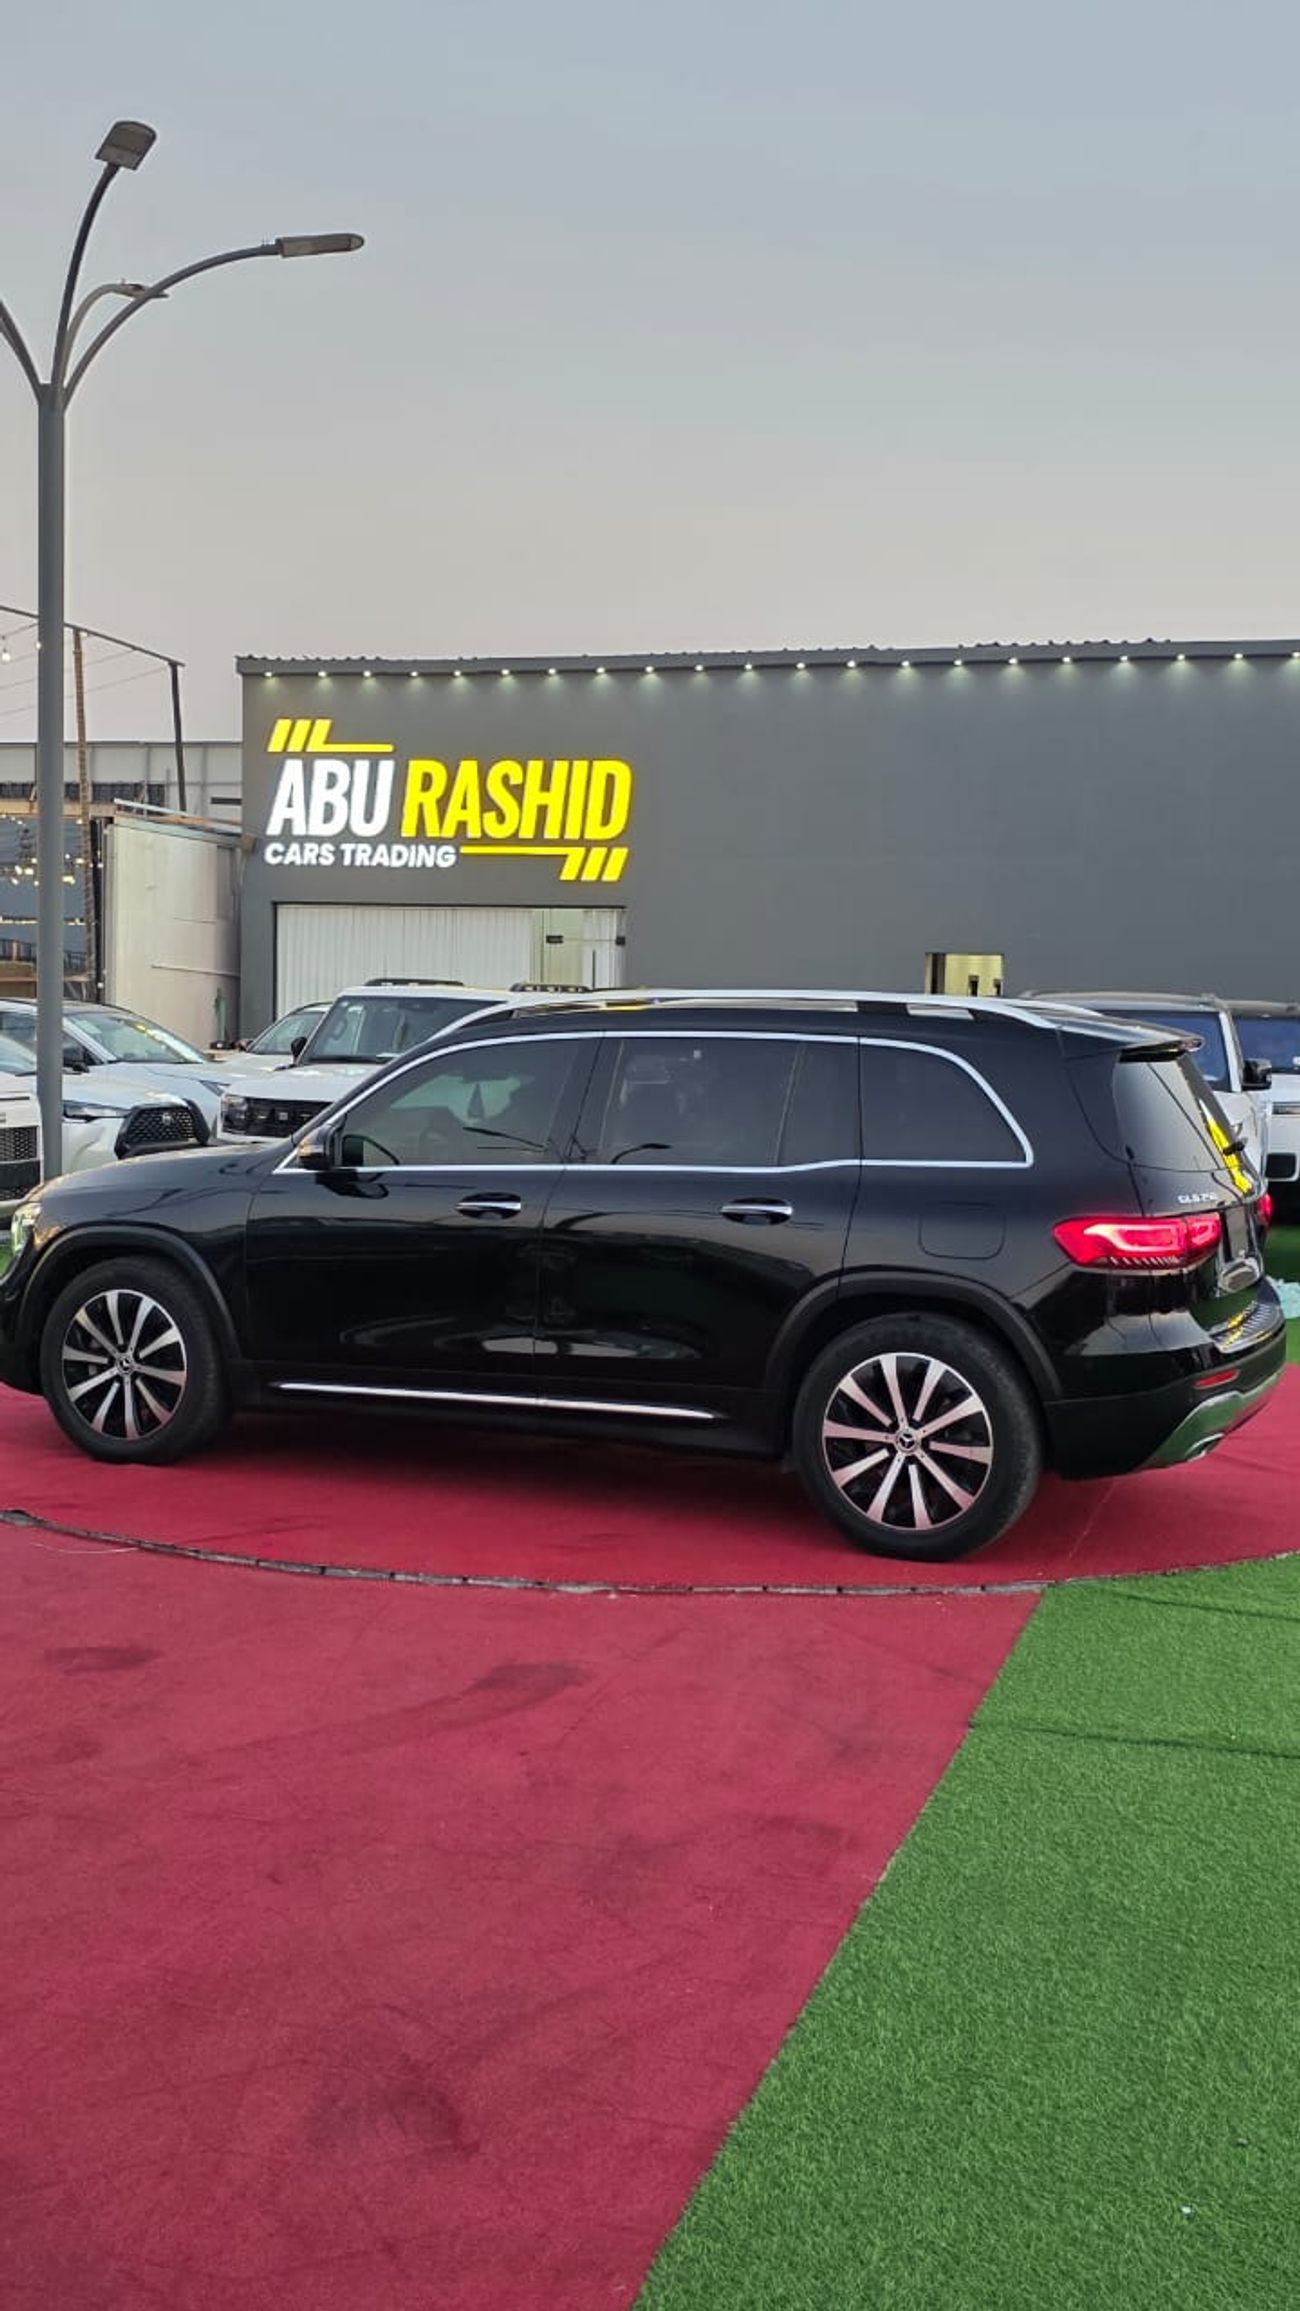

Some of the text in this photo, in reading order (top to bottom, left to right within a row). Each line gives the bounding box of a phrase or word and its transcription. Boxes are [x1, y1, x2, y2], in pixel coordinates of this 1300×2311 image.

[266, 758, 632, 840] ABU RASHID
[264, 842, 456, 868] CARS TRADING
